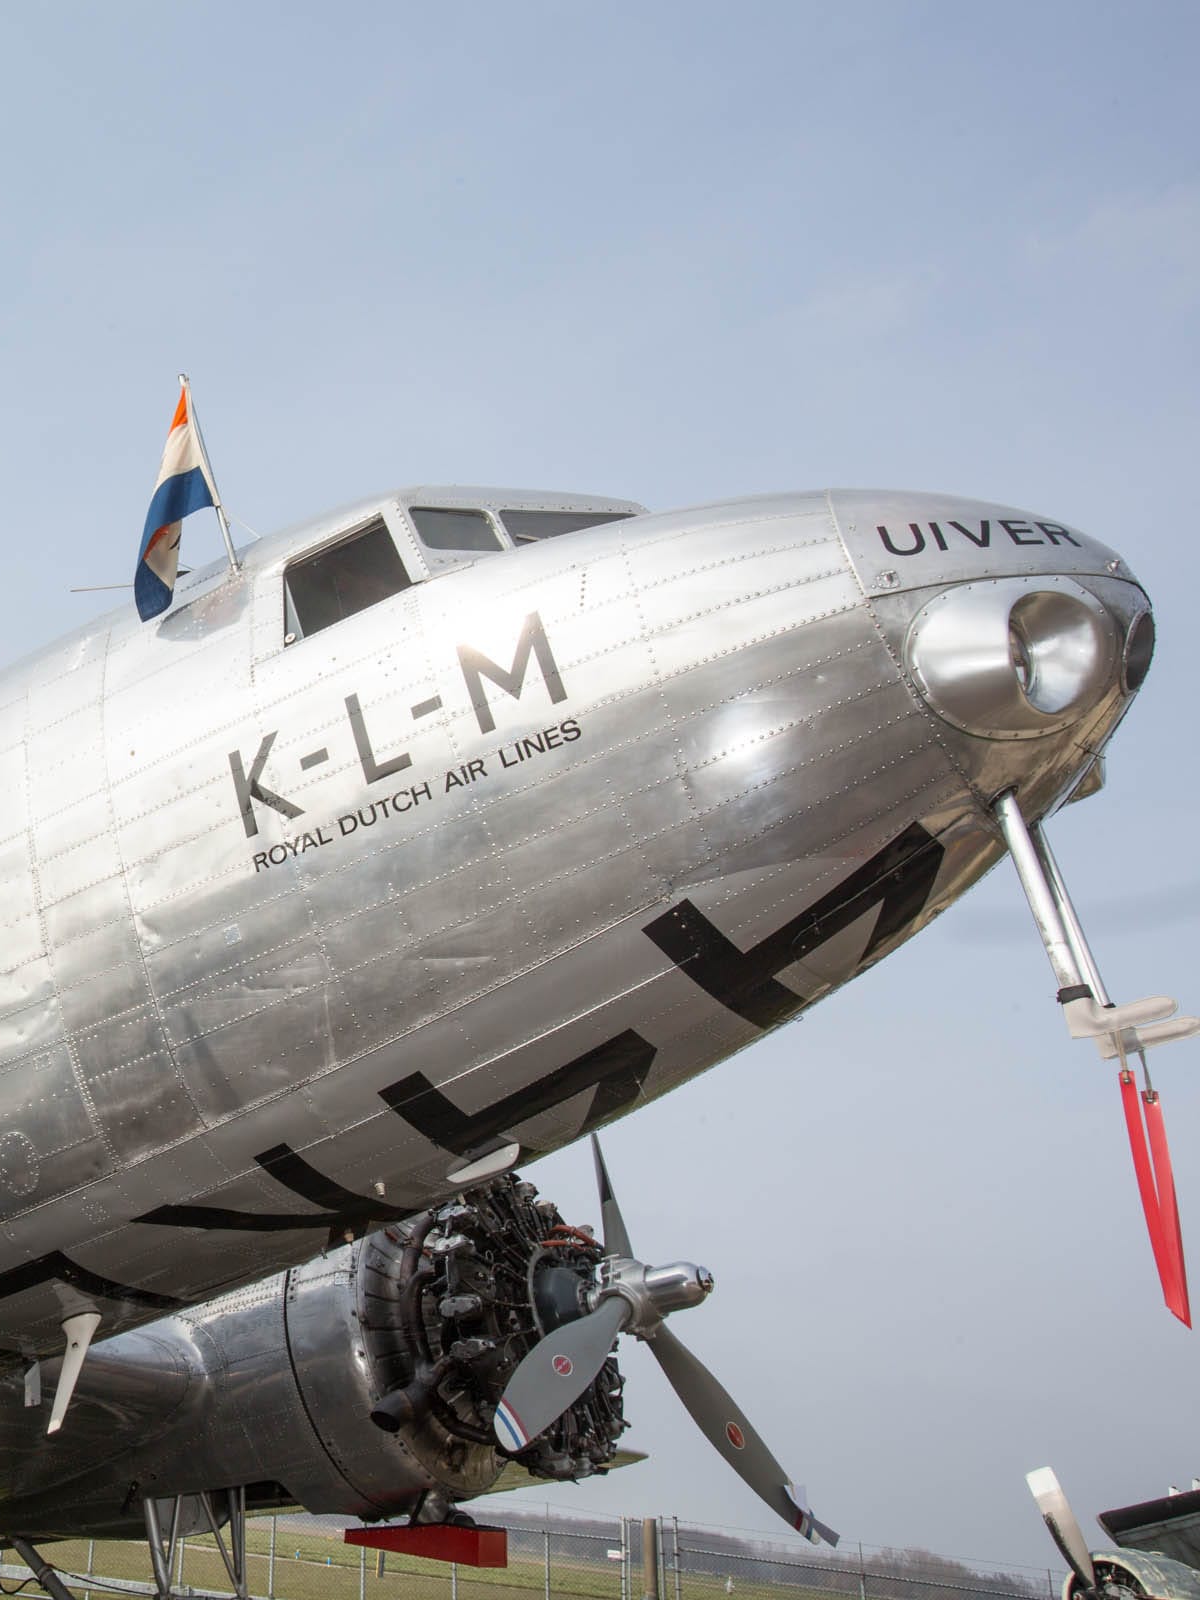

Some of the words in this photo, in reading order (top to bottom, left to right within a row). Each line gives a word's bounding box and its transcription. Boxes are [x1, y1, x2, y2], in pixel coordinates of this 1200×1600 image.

[876, 519, 1083, 556] UIVER
[228, 610, 568, 839] K-L-M
[252, 827, 333, 873] ROYAL
[339, 782, 432, 837] DUTCH
[444, 759, 488, 793] AIR
[497, 718, 583, 769] LINES
